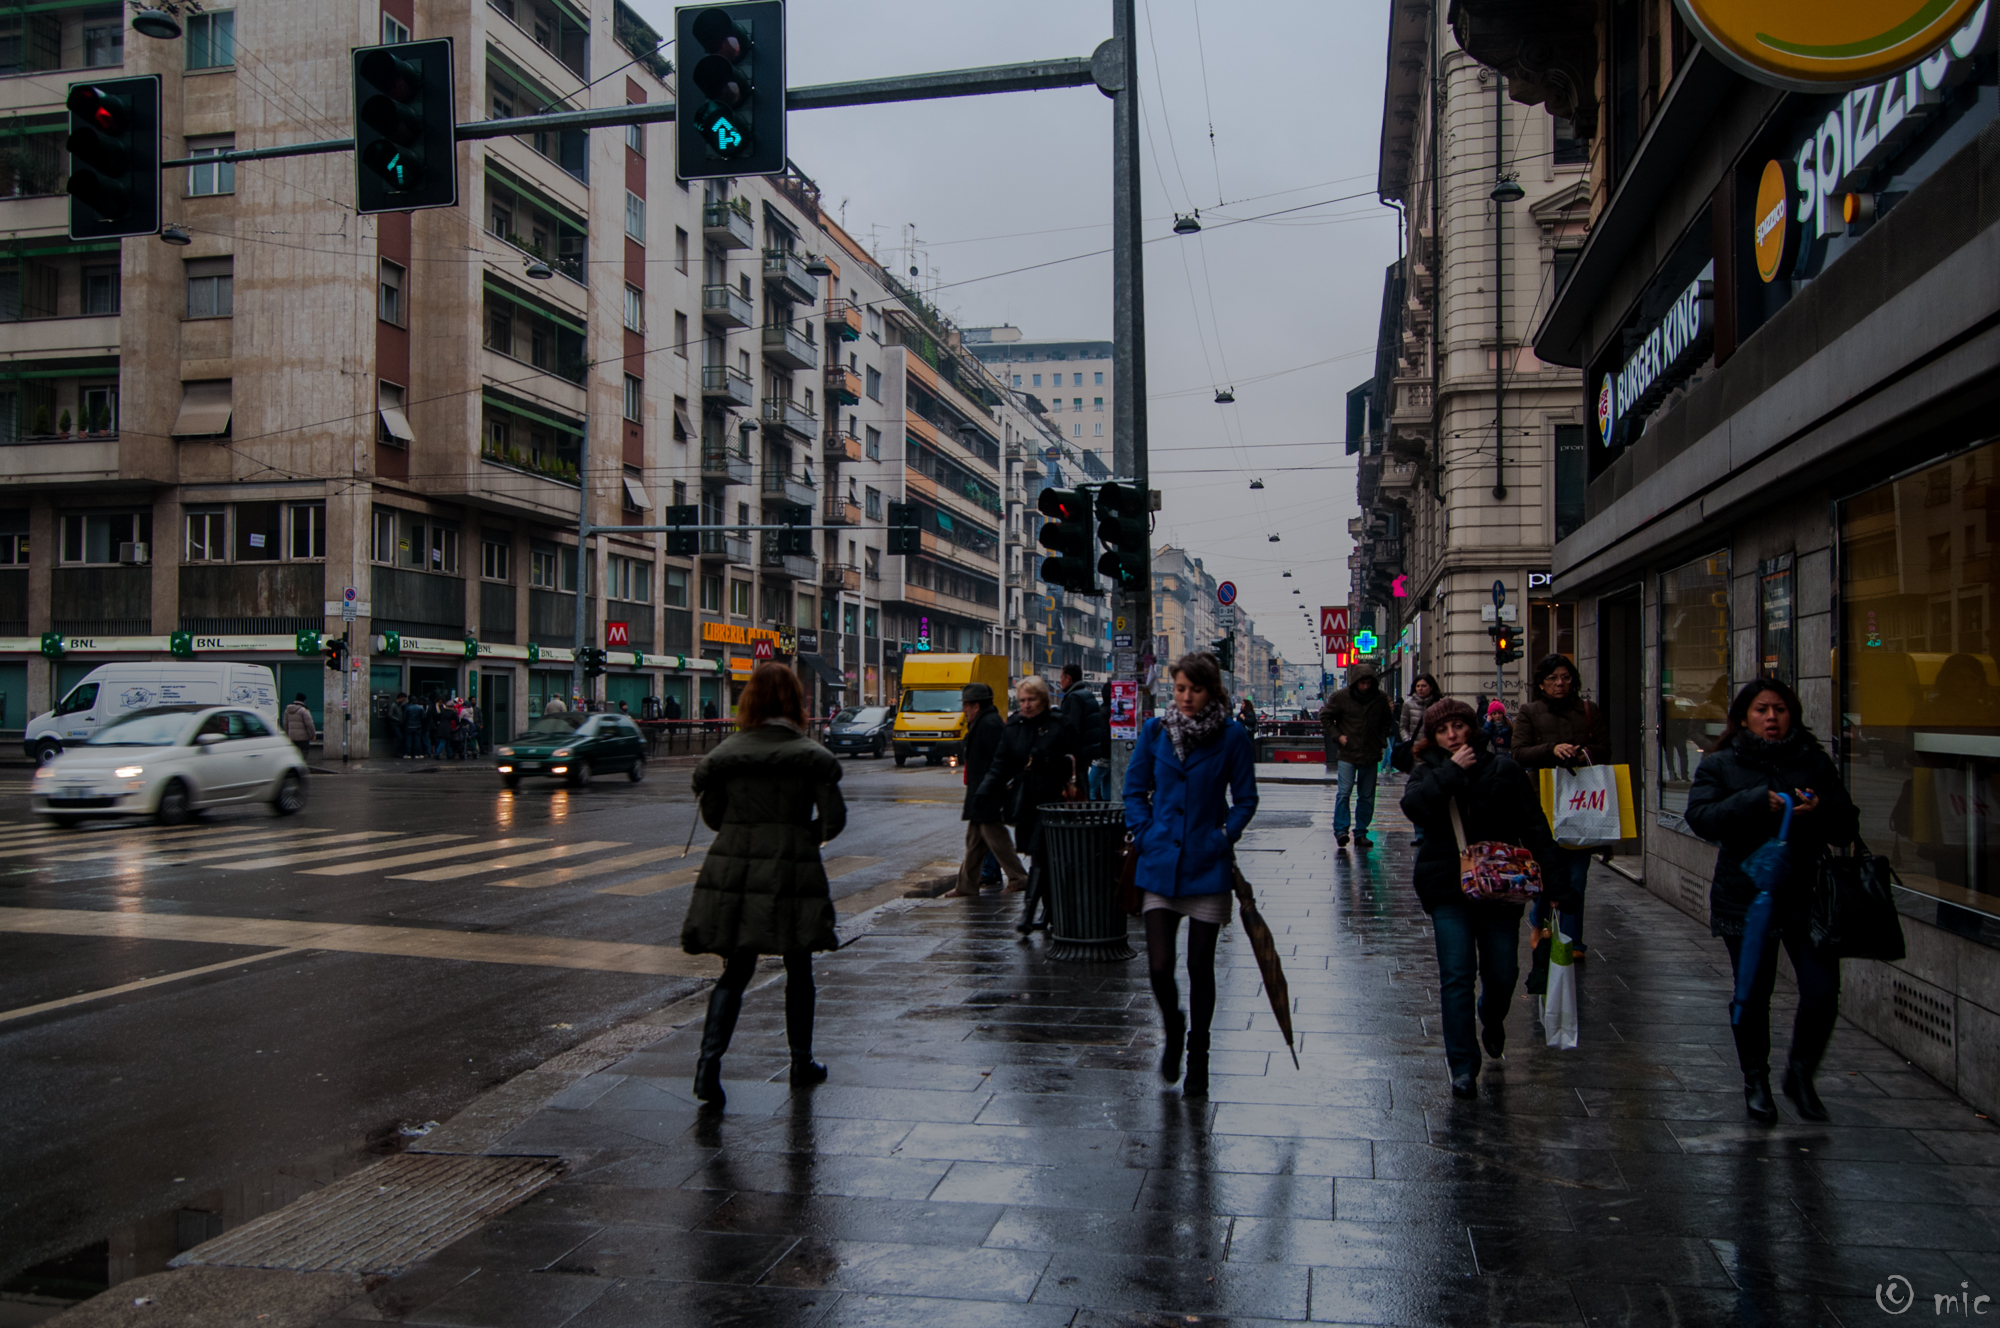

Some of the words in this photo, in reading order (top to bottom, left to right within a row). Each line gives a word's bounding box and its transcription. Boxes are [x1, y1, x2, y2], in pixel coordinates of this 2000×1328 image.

[1756, 199, 1785, 247] spizzico
[1617, 327, 1661, 420] BURGER
[1663, 280, 1701, 370] KING
[920, 617, 928, 637] BAR
[1323, 613, 1346, 630] M
[608, 627, 627, 641] M
[703, 622, 746, 645] LIBRERIA
[70, 639, 97, 648] BNL
[197, 638, 225, 648] BNL
[402, 639, 420, 649] BNL
[477, 644, 493, 654] BNL
[755, 643, 771, 656] M
[1327, 637, 1346, 650] M
[541, 649, 554, 658] BNL
[1569, 789, 1605, 811] H&M
